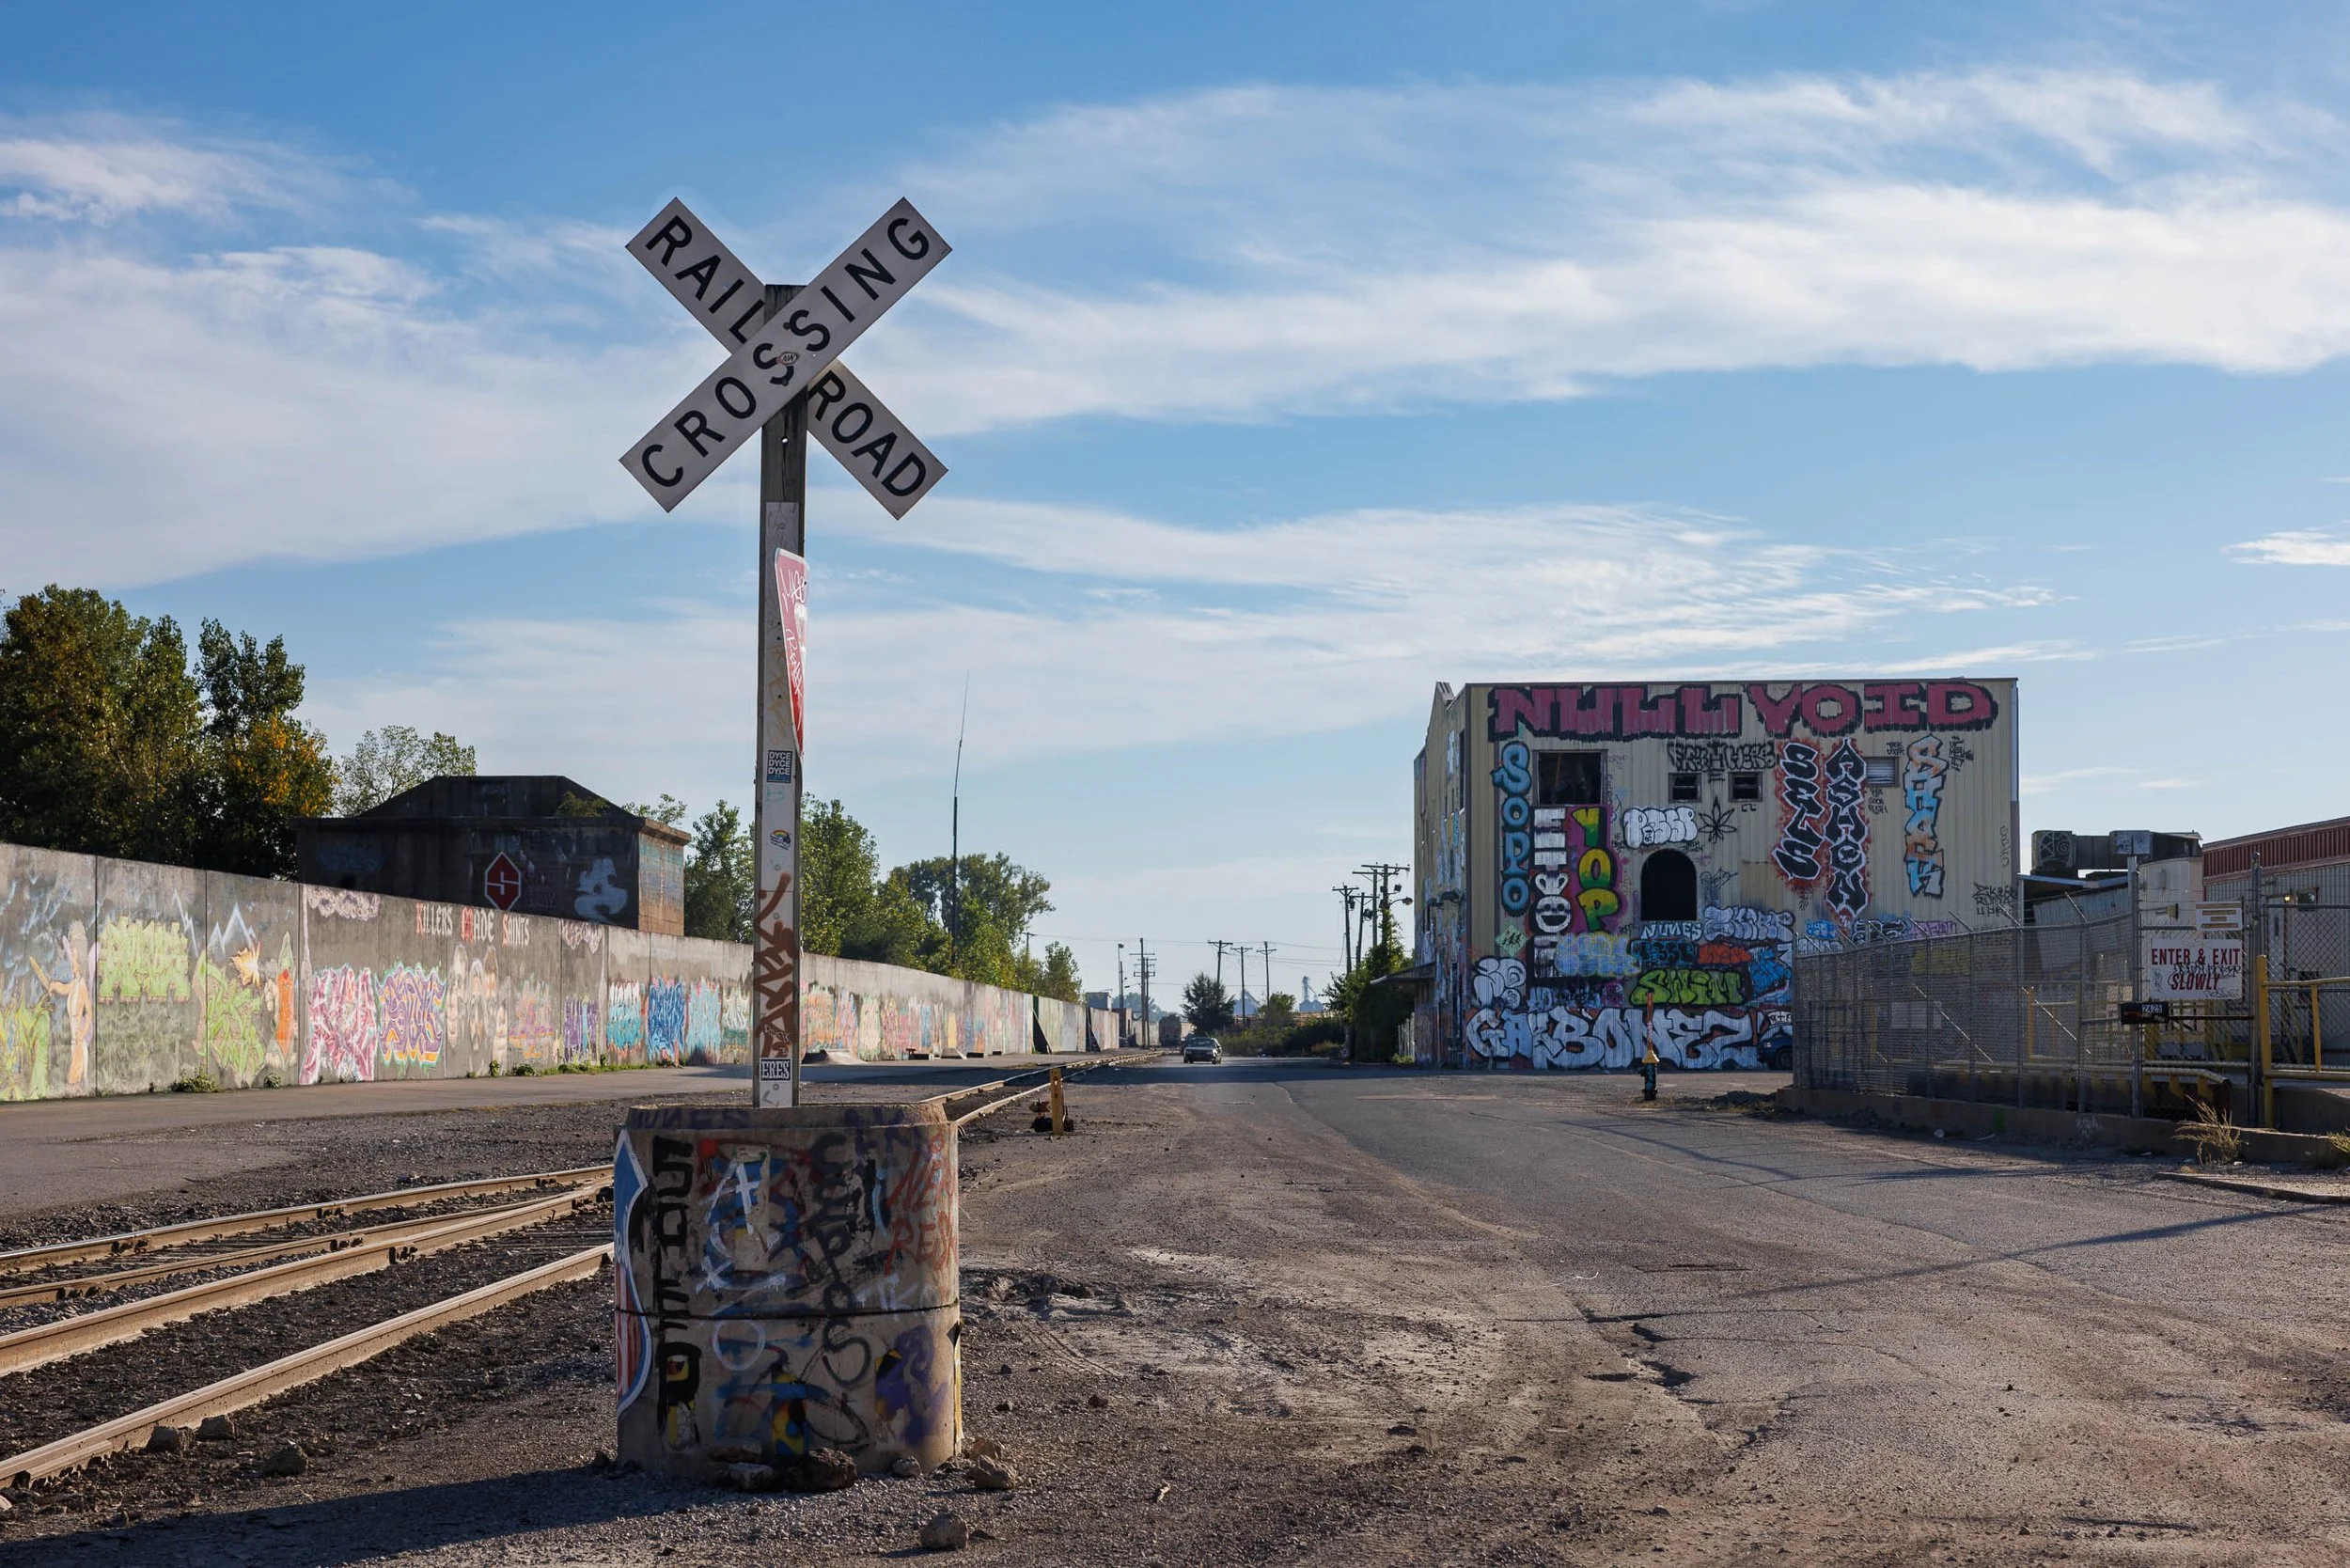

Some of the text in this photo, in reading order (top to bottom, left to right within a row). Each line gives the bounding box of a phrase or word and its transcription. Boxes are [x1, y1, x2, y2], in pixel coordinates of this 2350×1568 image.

[641, 218, 930, 487] CROSSING
[1488, 685, 1742, 743] NULL
[1491, 741, 1531, 917] SOPO
[415, 902, 453, 938] KILLERS
[502, 913, 530, 948] SAINTS
[2151, 948, 2241, 965] ENTER & EXIT
[2170, 973, 2220, 990] SLOWLY
[761, 1060, 790, 1079] ERES
